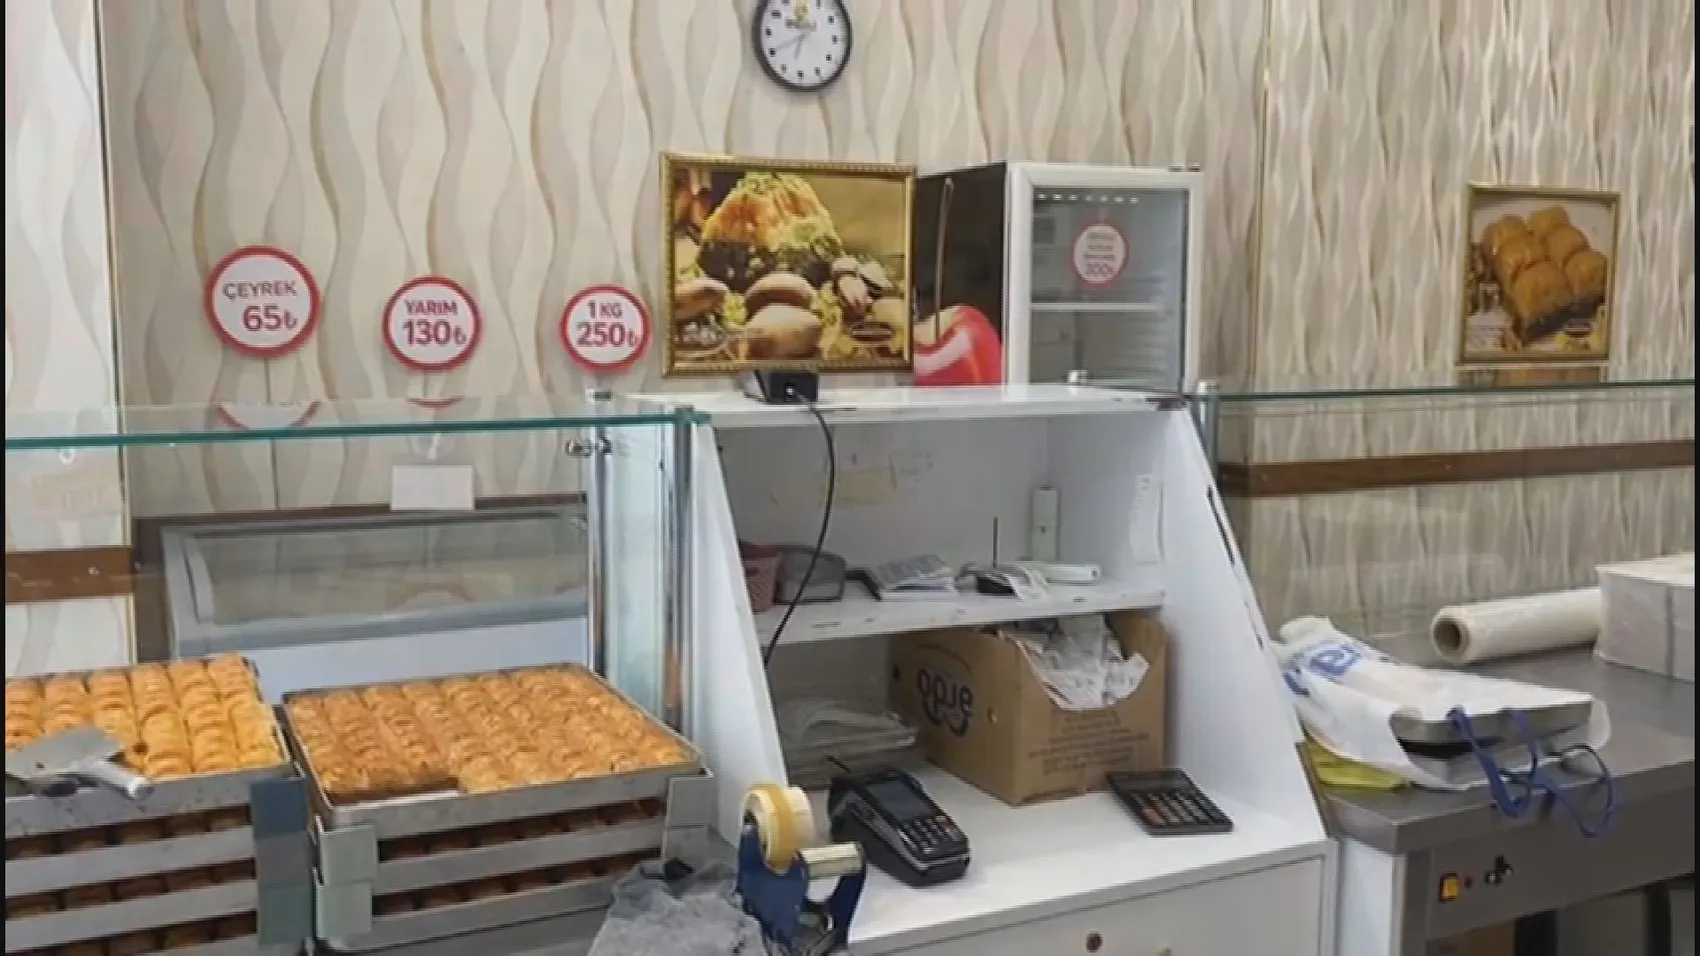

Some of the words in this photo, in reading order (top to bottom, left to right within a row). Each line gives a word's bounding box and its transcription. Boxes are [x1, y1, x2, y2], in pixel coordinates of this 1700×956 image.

[222, 280, 298, 301] ÇEYREK
[403, 300, 458, 316] YARIM
[586, 300, 596, 319] 1
[600, 302, 623, 319] KG
